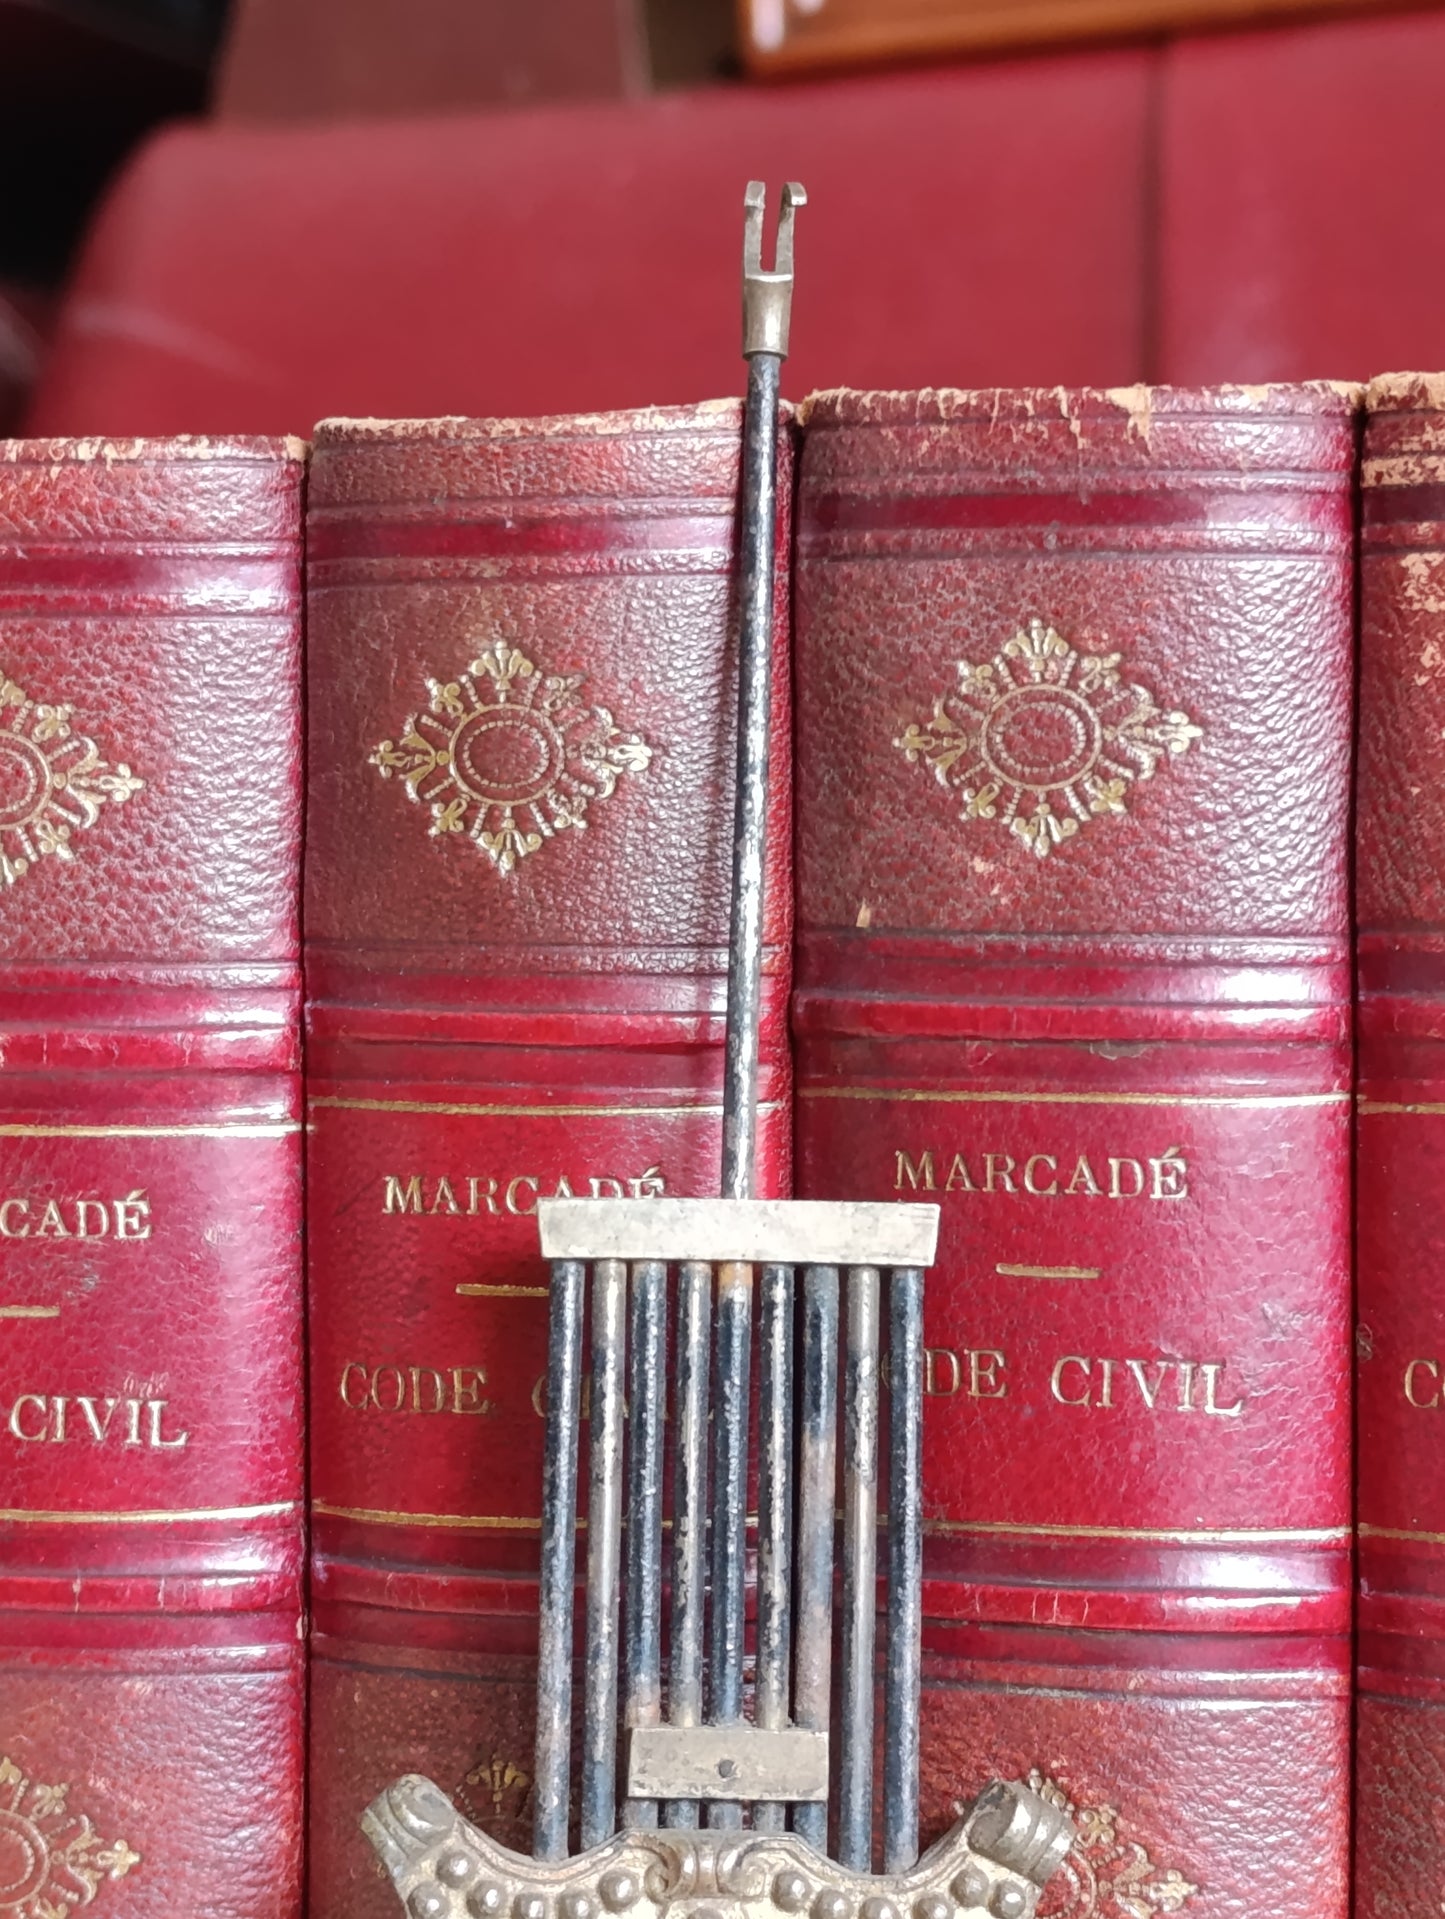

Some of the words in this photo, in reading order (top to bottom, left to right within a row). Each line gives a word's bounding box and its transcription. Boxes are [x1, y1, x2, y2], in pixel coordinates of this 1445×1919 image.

[894, 1145, 1188, 1200] MARCADÉ
[0, 1187, 152, 1240] CADÉ
[339, 1362, 489, 1415] CODE
[880, 1347, 1007, 1398] DE
[1050, 1354, 1244, 1417] CIVIL
[1404, 1358, 1445, 1409] C
[9, 1394, 188, 1447] CIVIL
